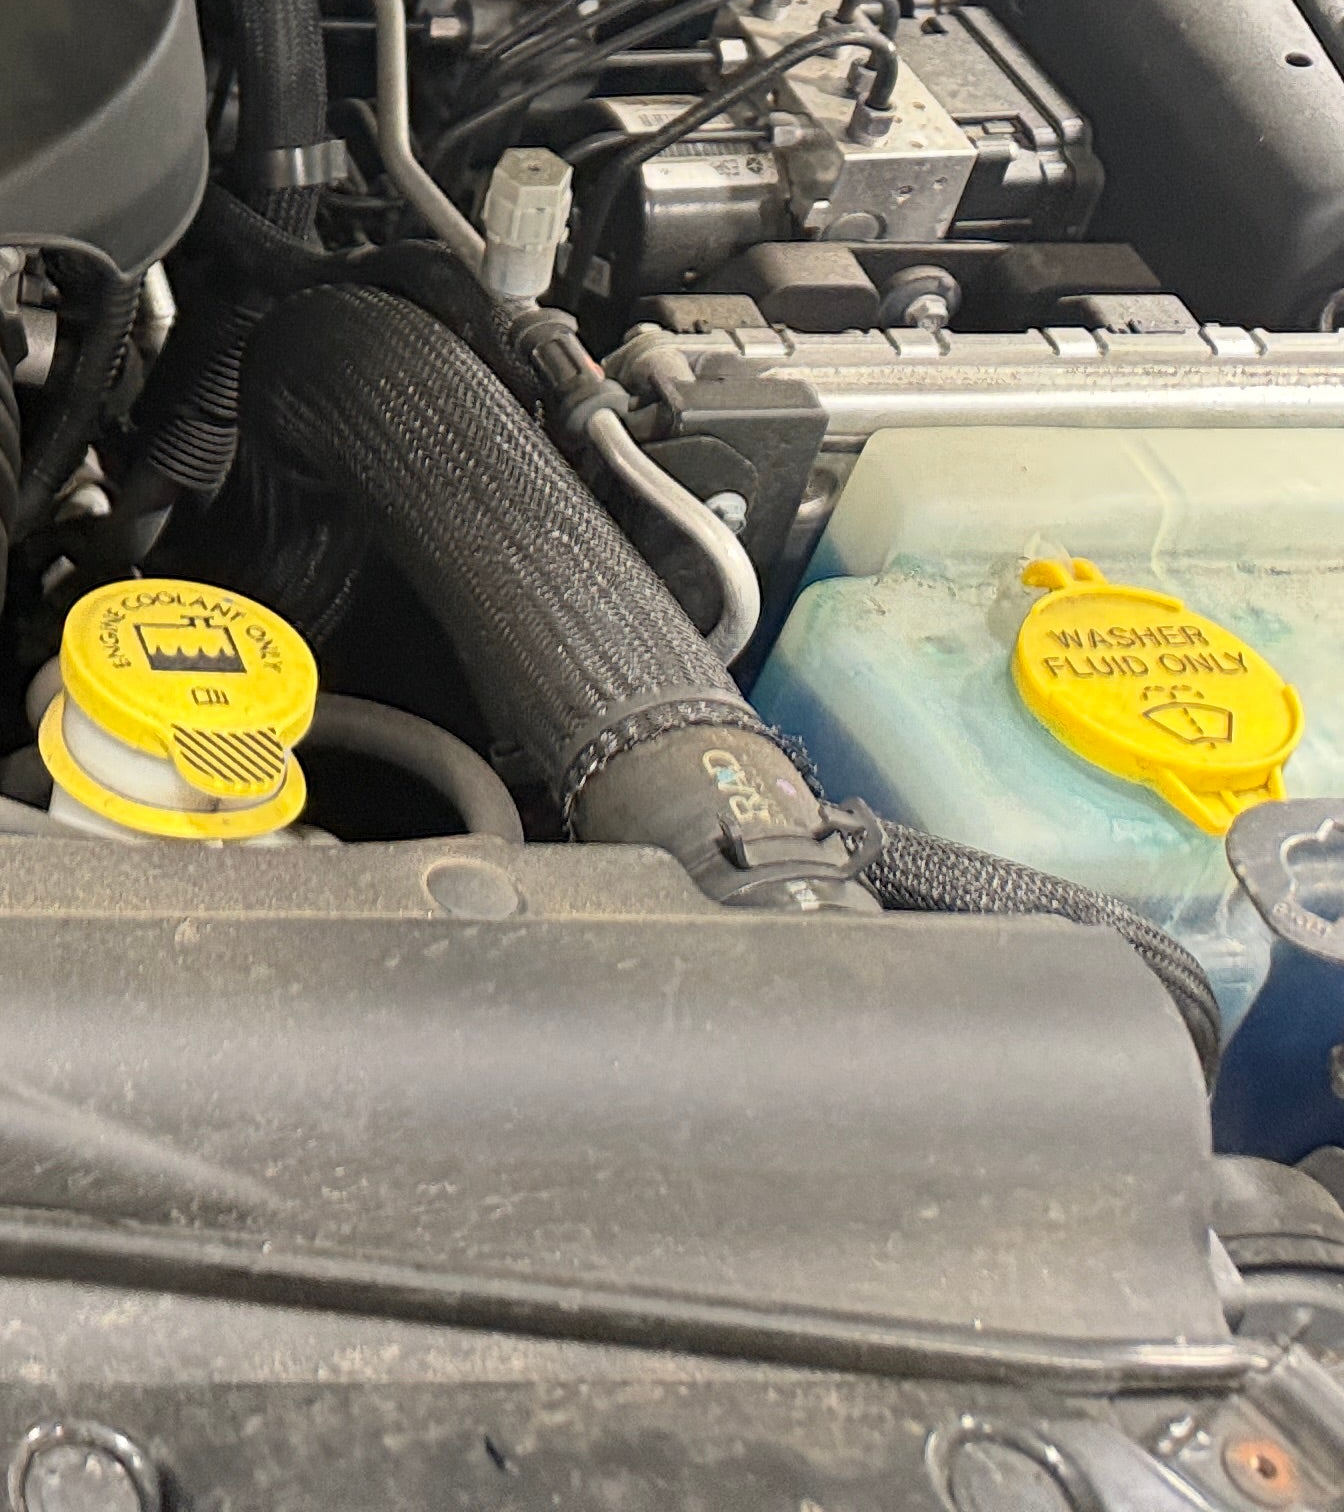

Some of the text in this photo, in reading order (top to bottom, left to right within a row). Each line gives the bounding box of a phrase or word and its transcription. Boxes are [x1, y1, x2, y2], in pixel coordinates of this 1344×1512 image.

[99, 590, 283, 674] ENGINE COOLANT ONLY
[1047, 625, 1210, 649] WASHER
[1042, 651, 1249, 679] FLUID ONLY
